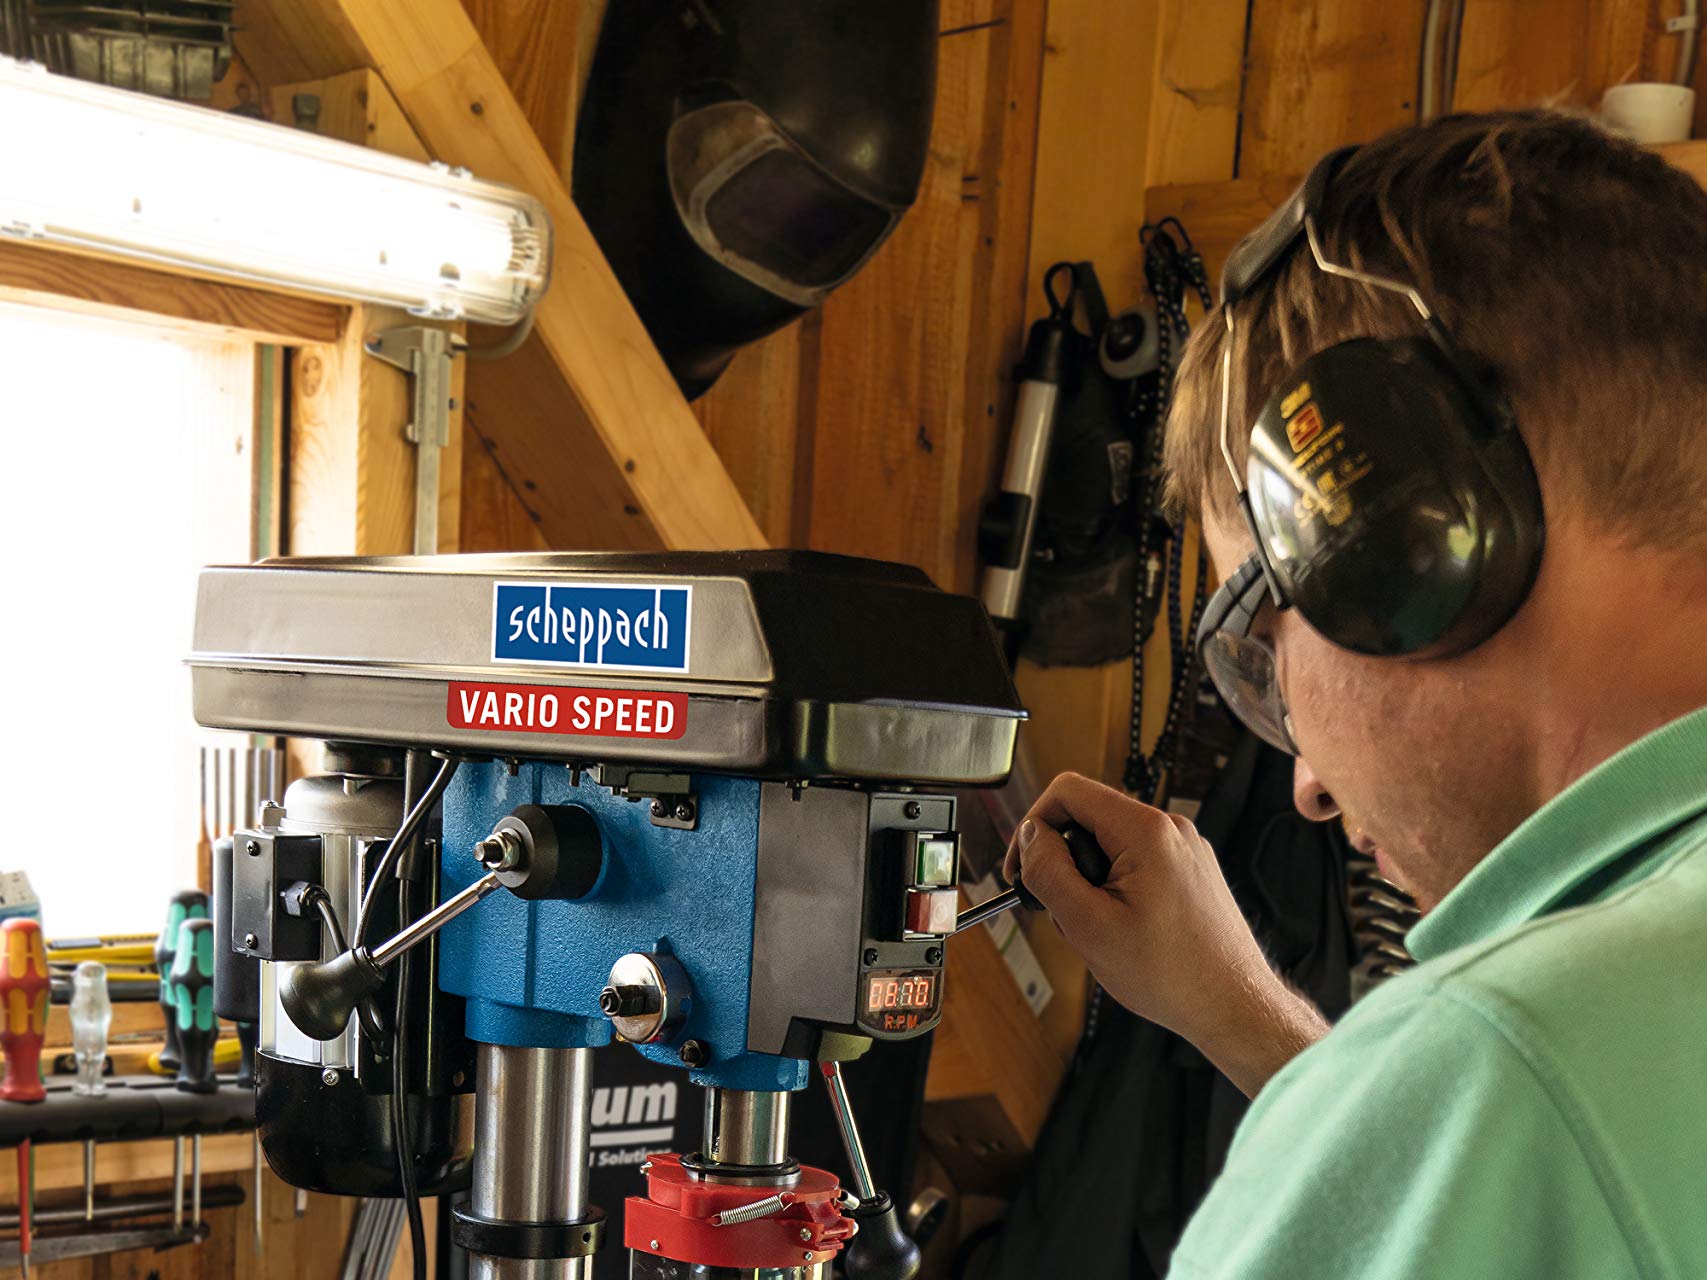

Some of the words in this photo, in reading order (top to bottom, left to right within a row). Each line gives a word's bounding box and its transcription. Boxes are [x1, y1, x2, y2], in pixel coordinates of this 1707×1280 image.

[508, 586, 669, 664] scheppach
[459, 689, 559, 728] VARIO
[571, 695, 675, 734] SPEED
[598, 1147, 672, 1167] Soluti
